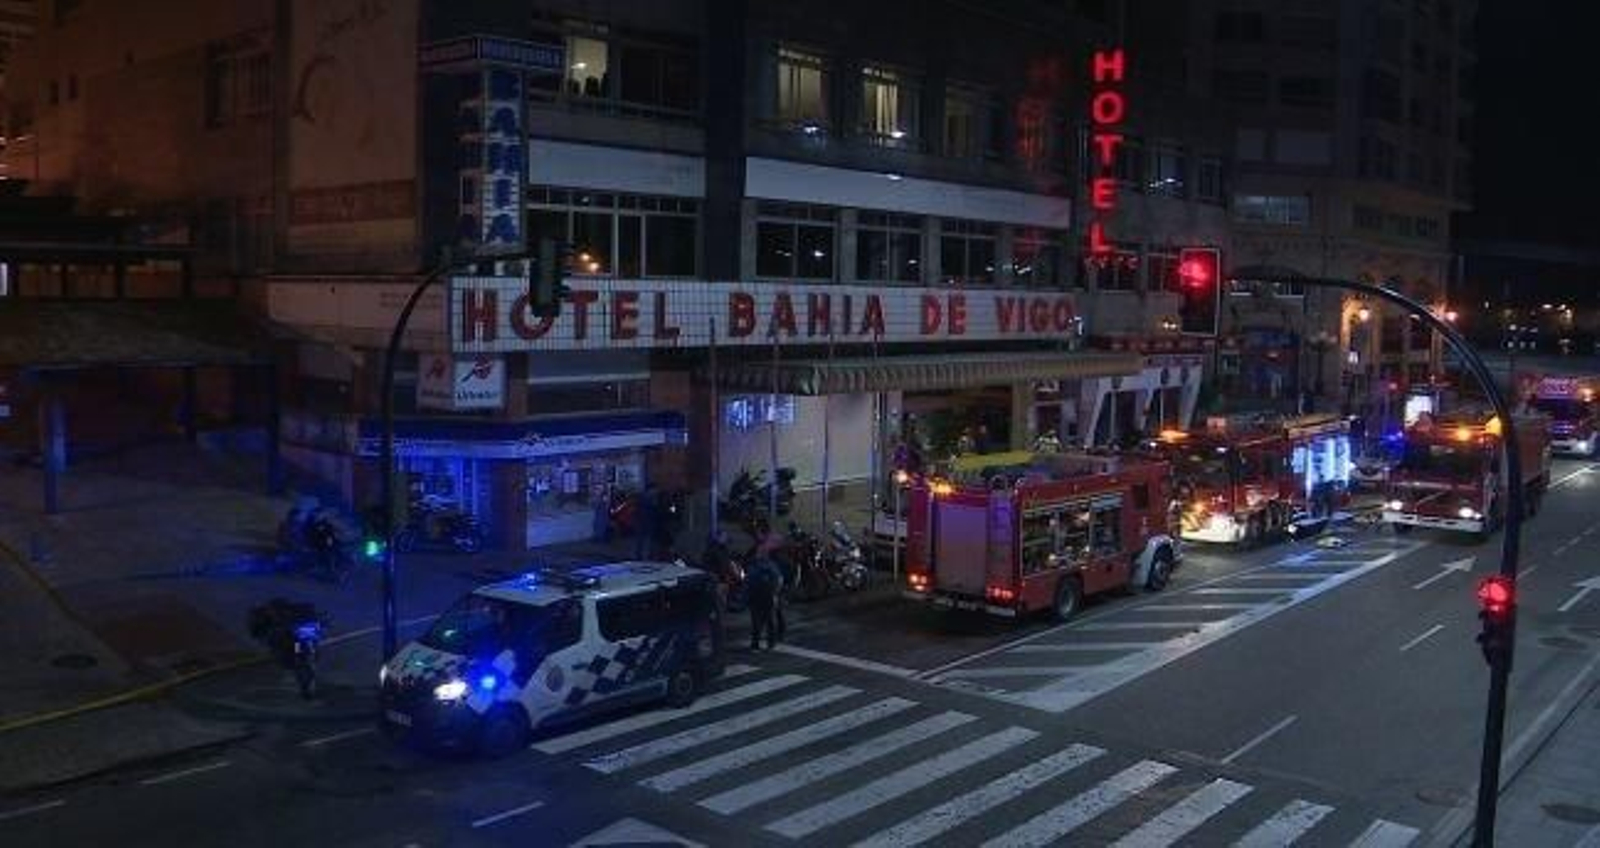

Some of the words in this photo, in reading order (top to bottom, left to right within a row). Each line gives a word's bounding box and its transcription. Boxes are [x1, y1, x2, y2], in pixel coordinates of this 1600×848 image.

[1091, 51, 1124, 253] HOTEL
[463, 288, 680, 342] HOTEL
[729, 293, 886, 338] BAHIA
[920, 294, 968, 336] DE
[995, 296, 1075, 333] VIGO
